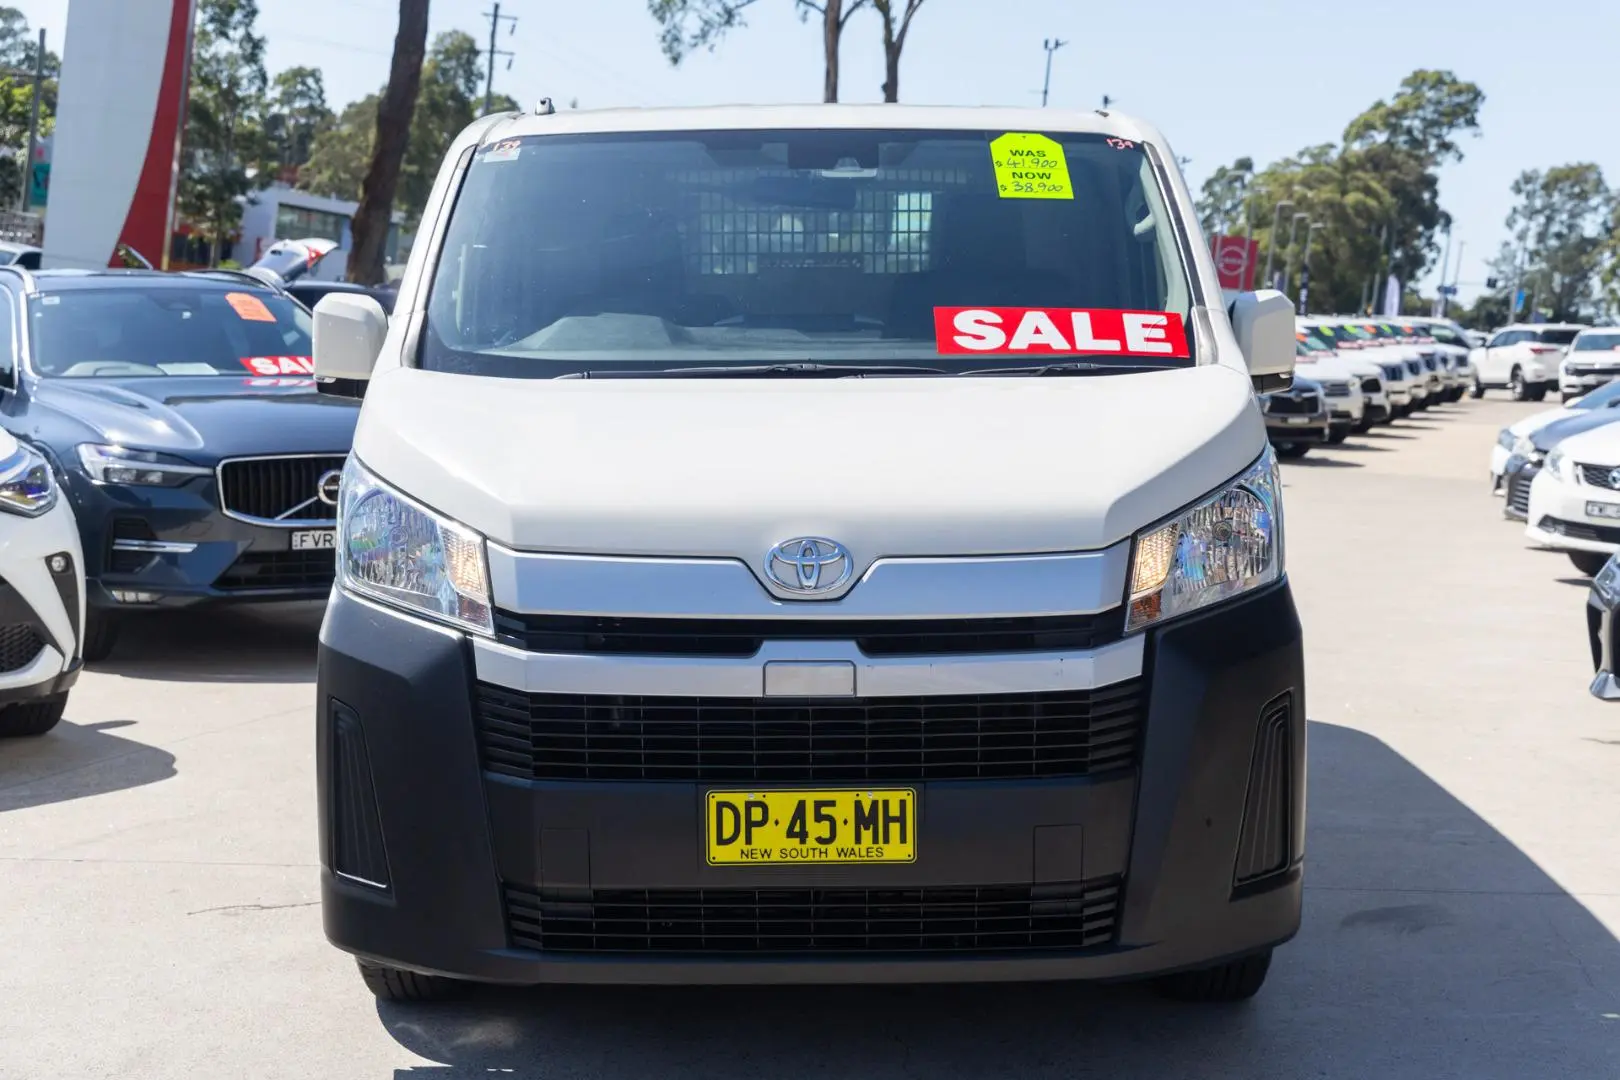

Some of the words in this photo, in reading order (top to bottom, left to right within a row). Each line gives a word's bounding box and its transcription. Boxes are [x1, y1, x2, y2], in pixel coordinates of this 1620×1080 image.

[1009, 149, 1047, 157] WAS
[1011, 171, 1052, 180] NOW
[953, 309, 1173, 353] SALE
[740, 848, 772, 859] NEW
[779, 847, 828, 859] SOUTH
[836, 847, 884, 858] WALES
